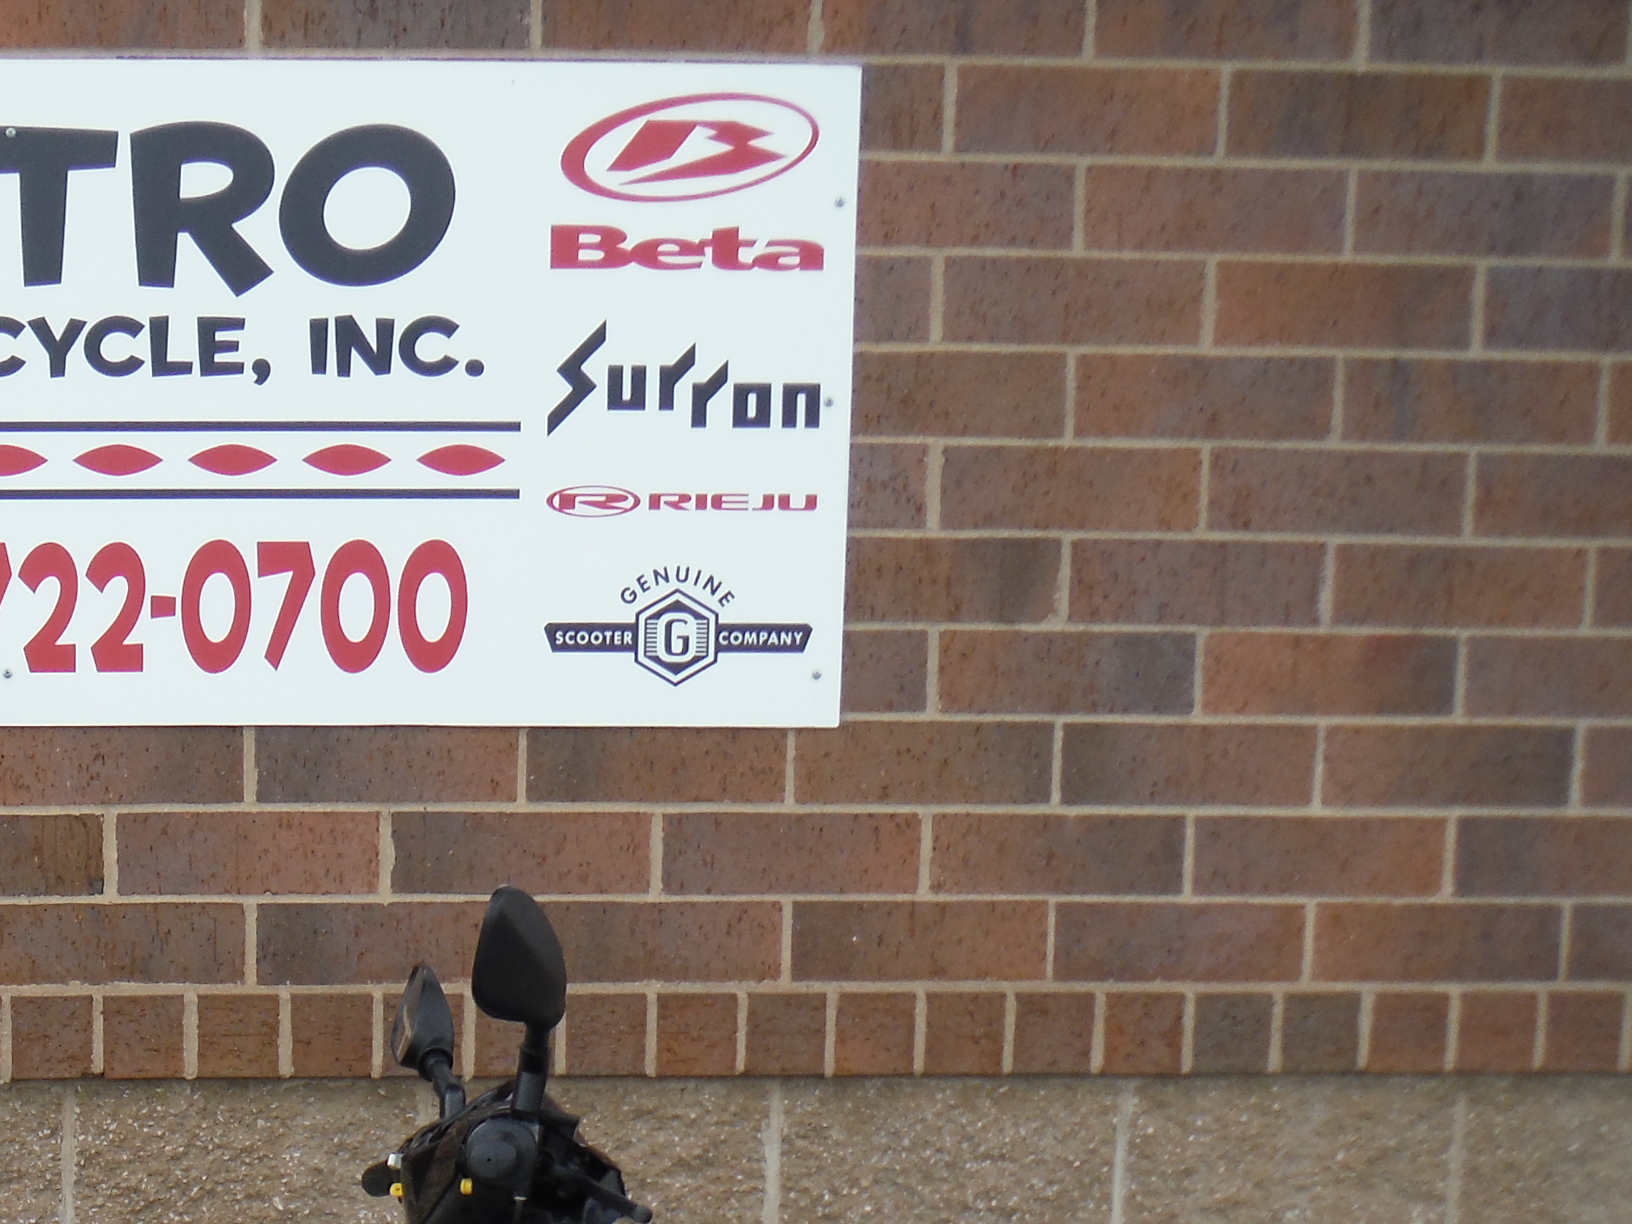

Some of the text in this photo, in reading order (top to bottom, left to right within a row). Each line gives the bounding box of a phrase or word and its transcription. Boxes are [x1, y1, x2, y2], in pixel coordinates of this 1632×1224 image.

[550, 224, 825, 271] Beta
[309, 315, 485, 378] INC.
[648, 492, 818, 512] RIEJU
[620, 565, 736, 608] GENUINE
[555, 631, 633, 646] SCOOTER
[718, 632, 804, 646] COMPANY
